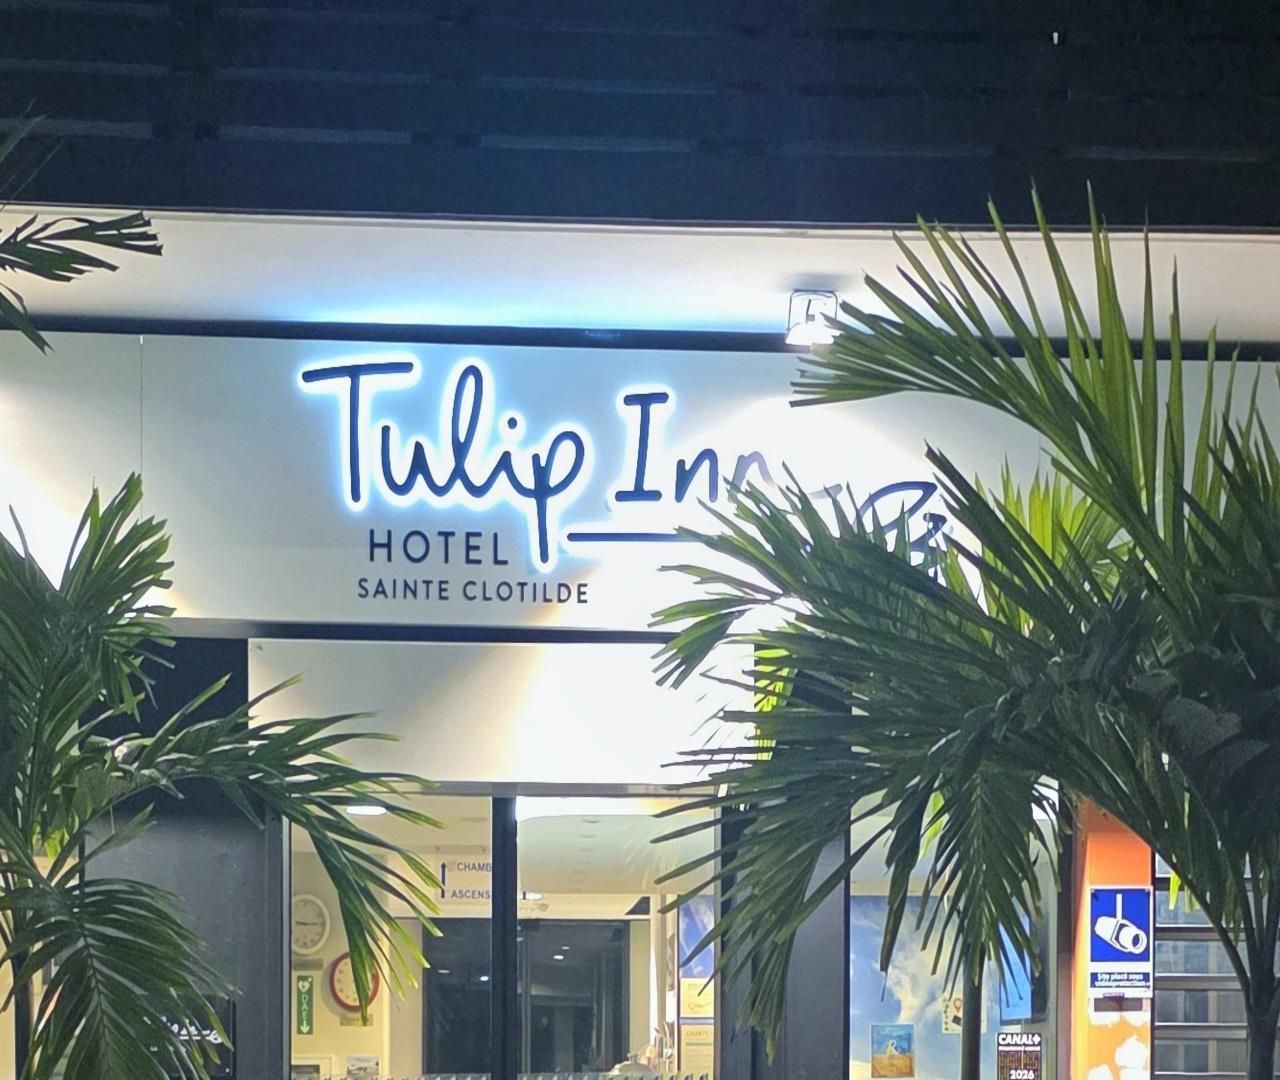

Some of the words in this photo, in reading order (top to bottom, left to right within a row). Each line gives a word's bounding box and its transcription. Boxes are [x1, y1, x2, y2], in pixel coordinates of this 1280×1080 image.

[301, 362, 585, 563] Tulip
[369, 528, 509, 566] HOTEL
[357, 578, 450, 602] SAINTE
[462, 580, 589, 604] CLOTILDE
[998, 1033, 1041, 1045] CANAL+
[1009, 1069, 1035, 1080] 2026
